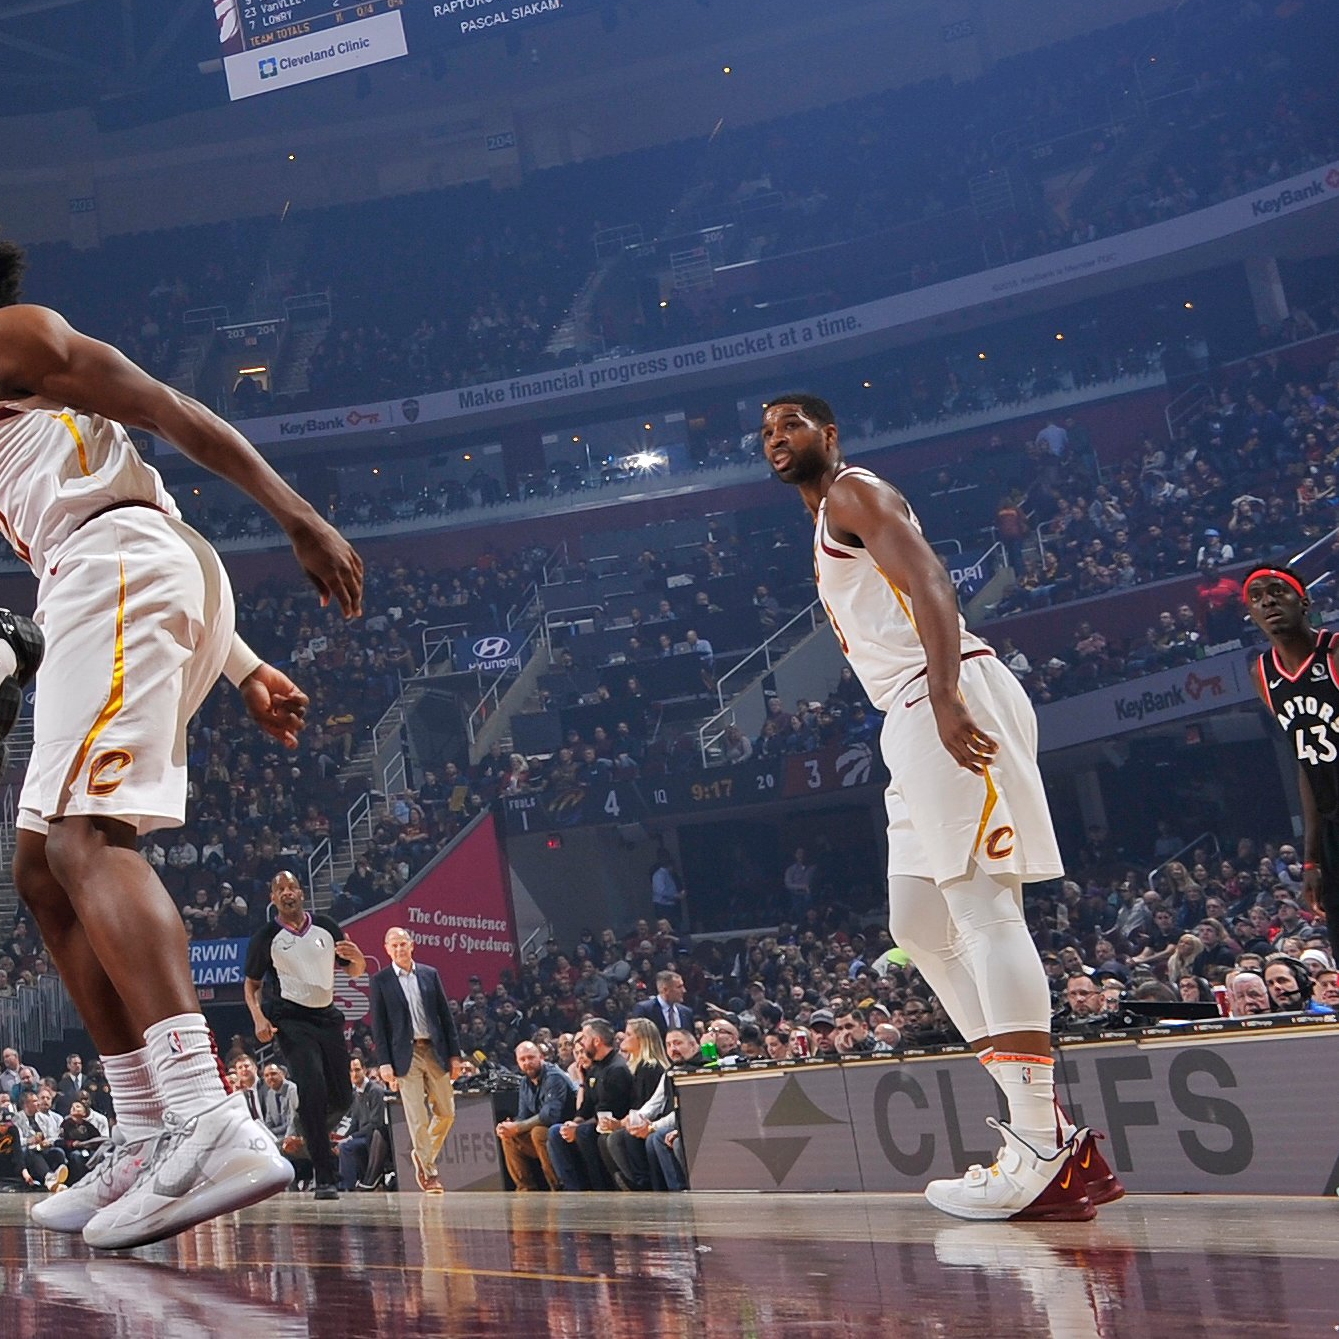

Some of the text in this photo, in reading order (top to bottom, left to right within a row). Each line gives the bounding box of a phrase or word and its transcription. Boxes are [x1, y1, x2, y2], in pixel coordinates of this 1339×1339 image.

[250, 23, 311, 47] TEAM TOTALS
[460, 11, 509, 34] PASCAL
[280, 37, 370, 70] Cleveland Clinic
[1252, 181, 1324, 218] KeyBank
[459, 313, 862, 410] Make financial progress one bucket at a time.
[280, 415, 345, 436] KeyBank
[1114, 683, 1186, 722] KeyBank
[1295, 725, 1338, 767] 43
[604, 791, 620, 818] 4
[692, 779, 733, 801] 9:17
[757, 773, 775, 790] 20
[805, 760, 821, 788] 3
[408, 906, 507, 932] The Convenience
[443, 932, 457, 952] of
[460, 934, 515, 958] Speedway
[873, 1050, 1255, 1178] CLFFS
